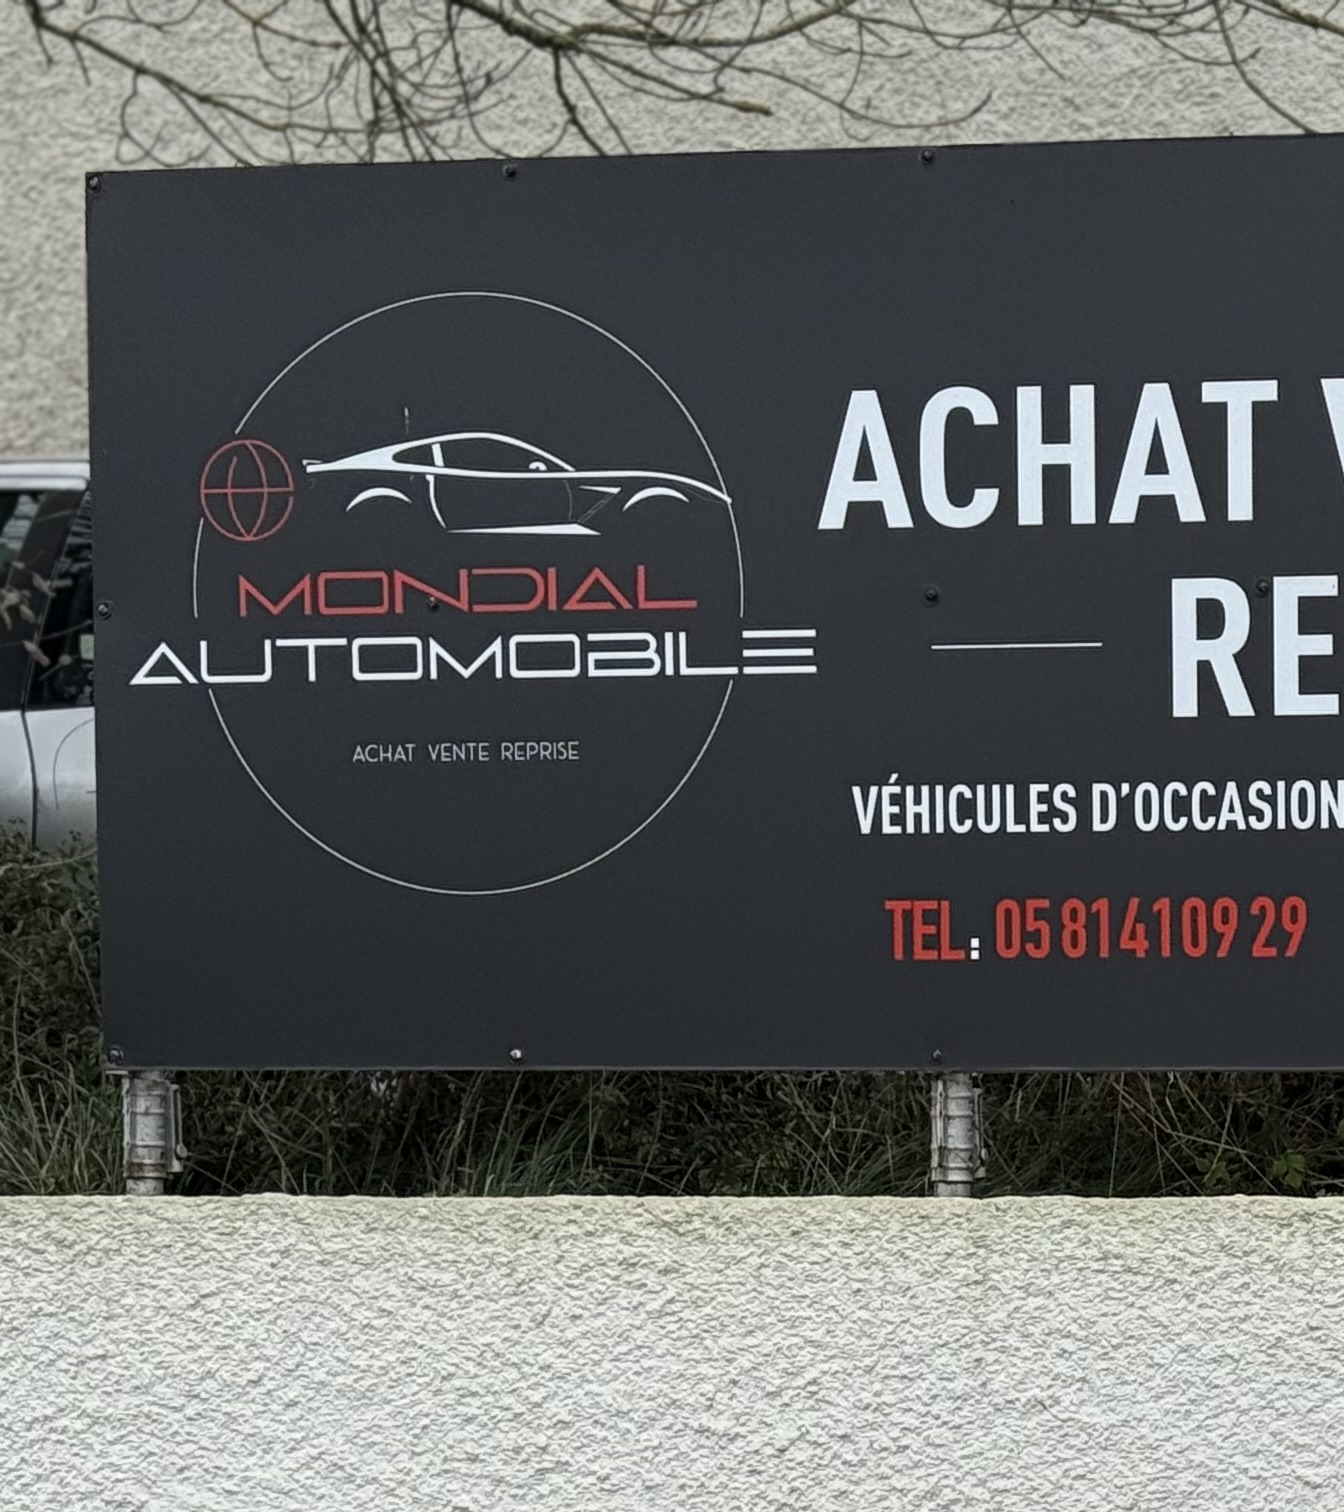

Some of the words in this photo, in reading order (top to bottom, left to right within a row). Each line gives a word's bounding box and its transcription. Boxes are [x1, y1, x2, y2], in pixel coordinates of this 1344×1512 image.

[818, 381, 1278, 531] ACHAT
[239, 565, 697, 617] MONDIAL
[129, 629, 818, 685] AUTOMOBILE
[352, 744, 416, 764] ACHAT
[427, 742, 491, 763] VENTE
[500, 740, 581, 762] REPRISE
[852, 773, 1079, 836] VÉHICULES
[884, 899, 981, 961] TEL:
